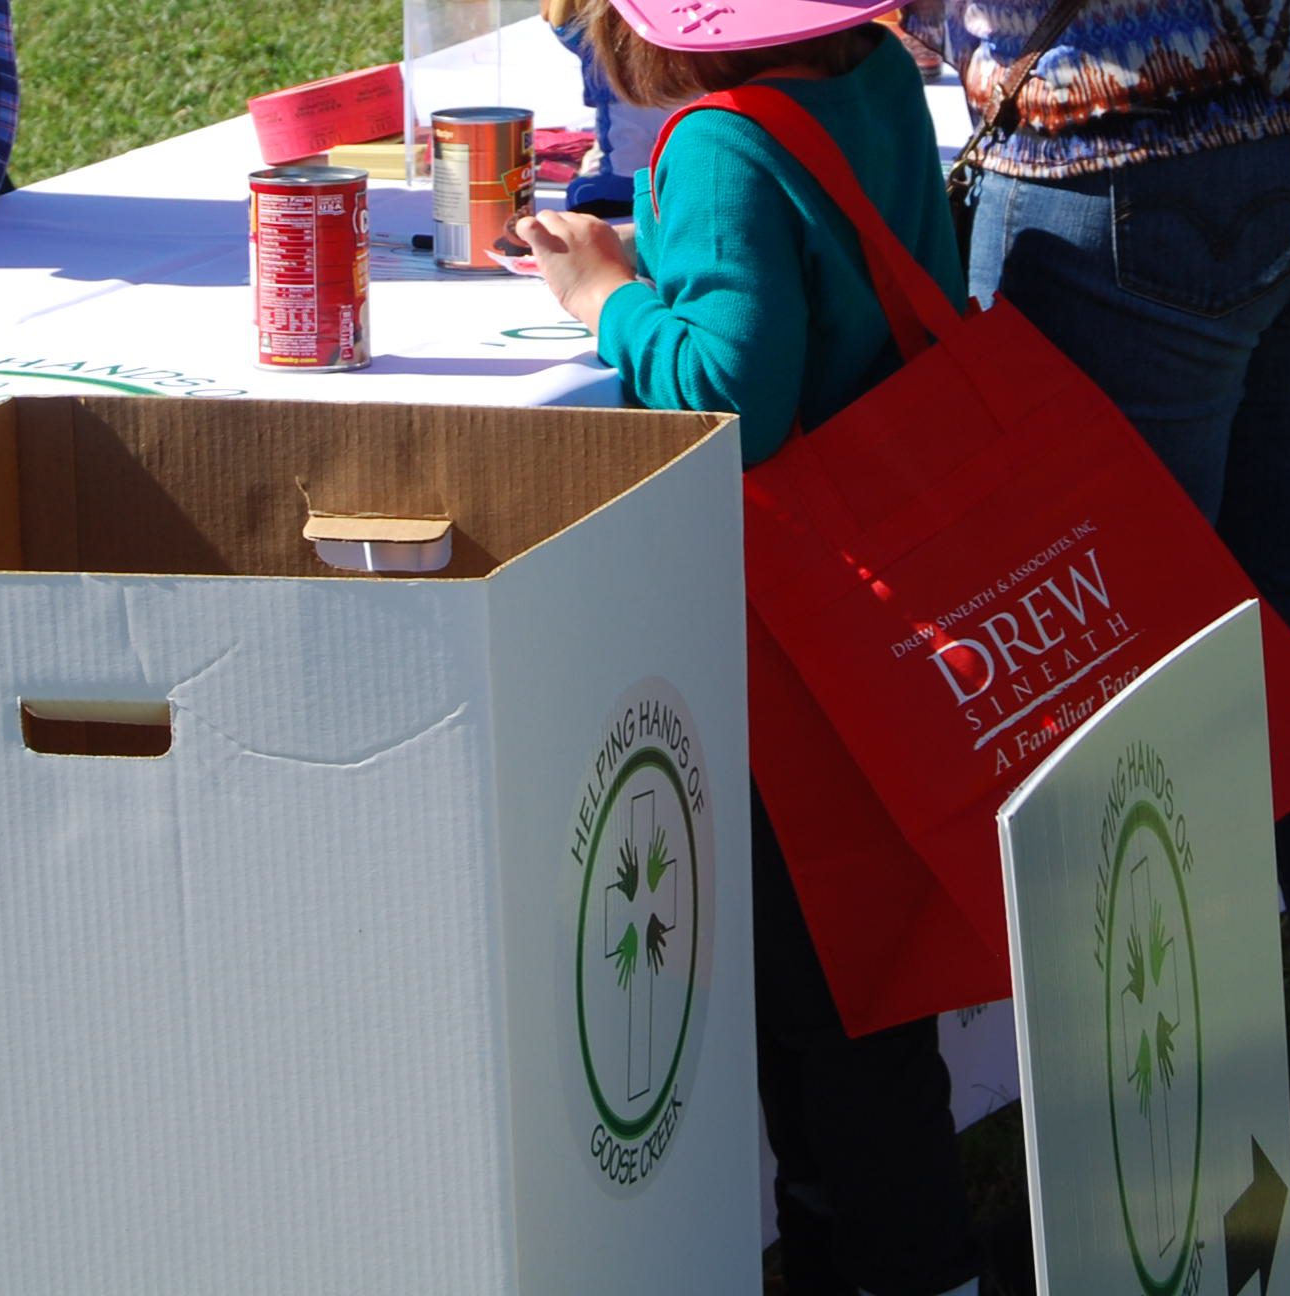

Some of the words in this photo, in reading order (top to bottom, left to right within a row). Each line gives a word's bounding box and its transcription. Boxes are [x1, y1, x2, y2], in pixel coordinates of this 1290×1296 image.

[890, 623, 936, 659] DREW
[936, 588, 997, 632] SINEATH
[996, 578, 1010, 594] &
[928, 548, 1111, 706] DREW
[965, 612, 1130, 731] SINEATH
[571, 707, 635, 866] HELPING
[639, 699, 691, 769] HANDS
[687, 766, 705, 815] OF
[994, 748, 1013, 776] A
[1014, 694, 1096, 760] Familiar
[1094, 756, 1126, 972] HELPING
[1126, 740, 1174, 821] HANDS
[1175, 814, 1195, 873] OF
[591, 1123, 638, 1185] GOOSE
[640, 1083, 683, 1178] CREEK
